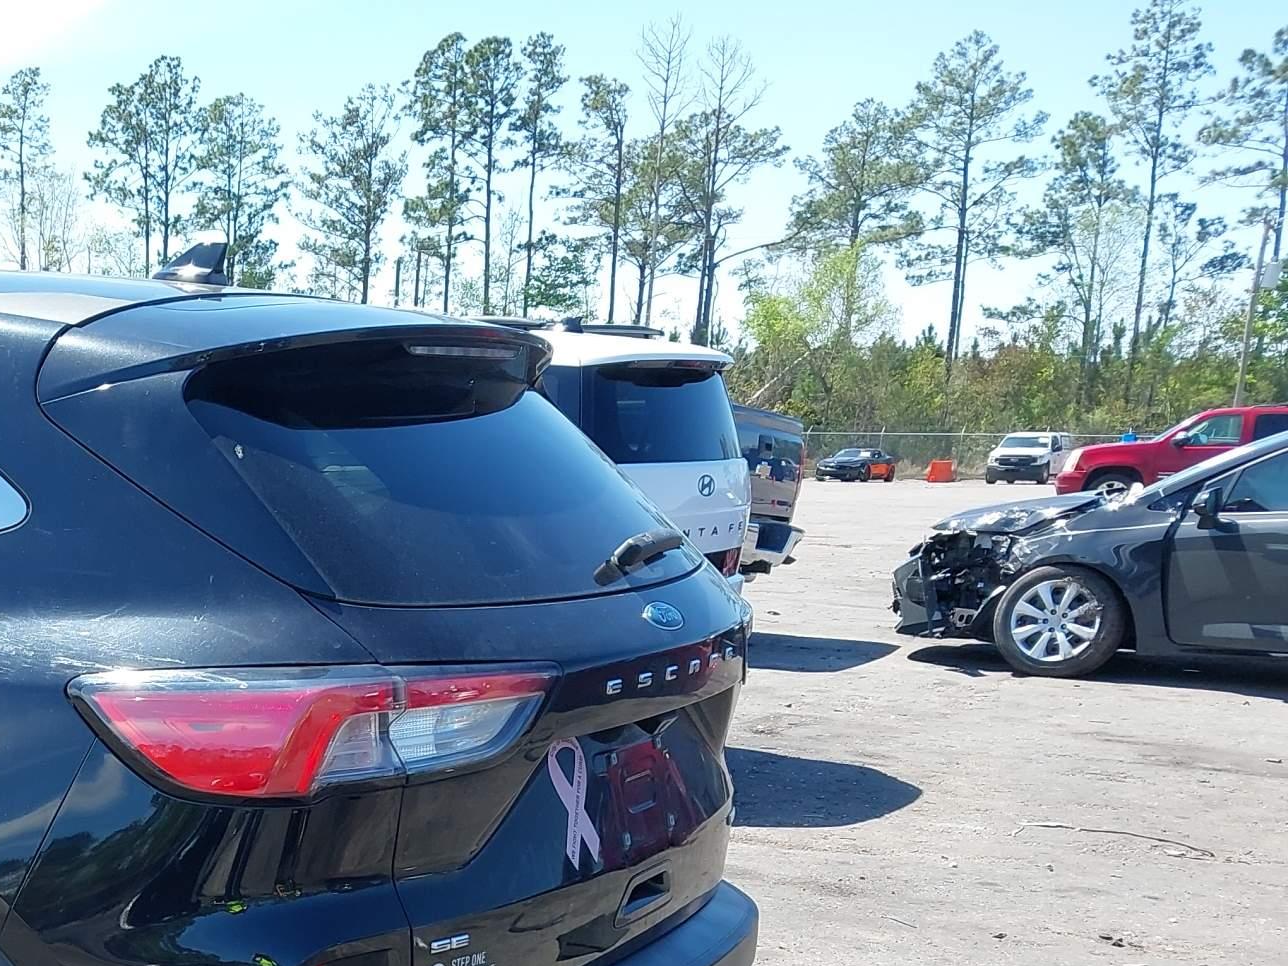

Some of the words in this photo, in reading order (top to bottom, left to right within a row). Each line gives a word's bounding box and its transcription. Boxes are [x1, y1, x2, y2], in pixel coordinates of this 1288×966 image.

[606, 646, 734, 695] ESCAPE
[430, 934, 469, 954] SE
[472, 951, 487, 966] ONE
